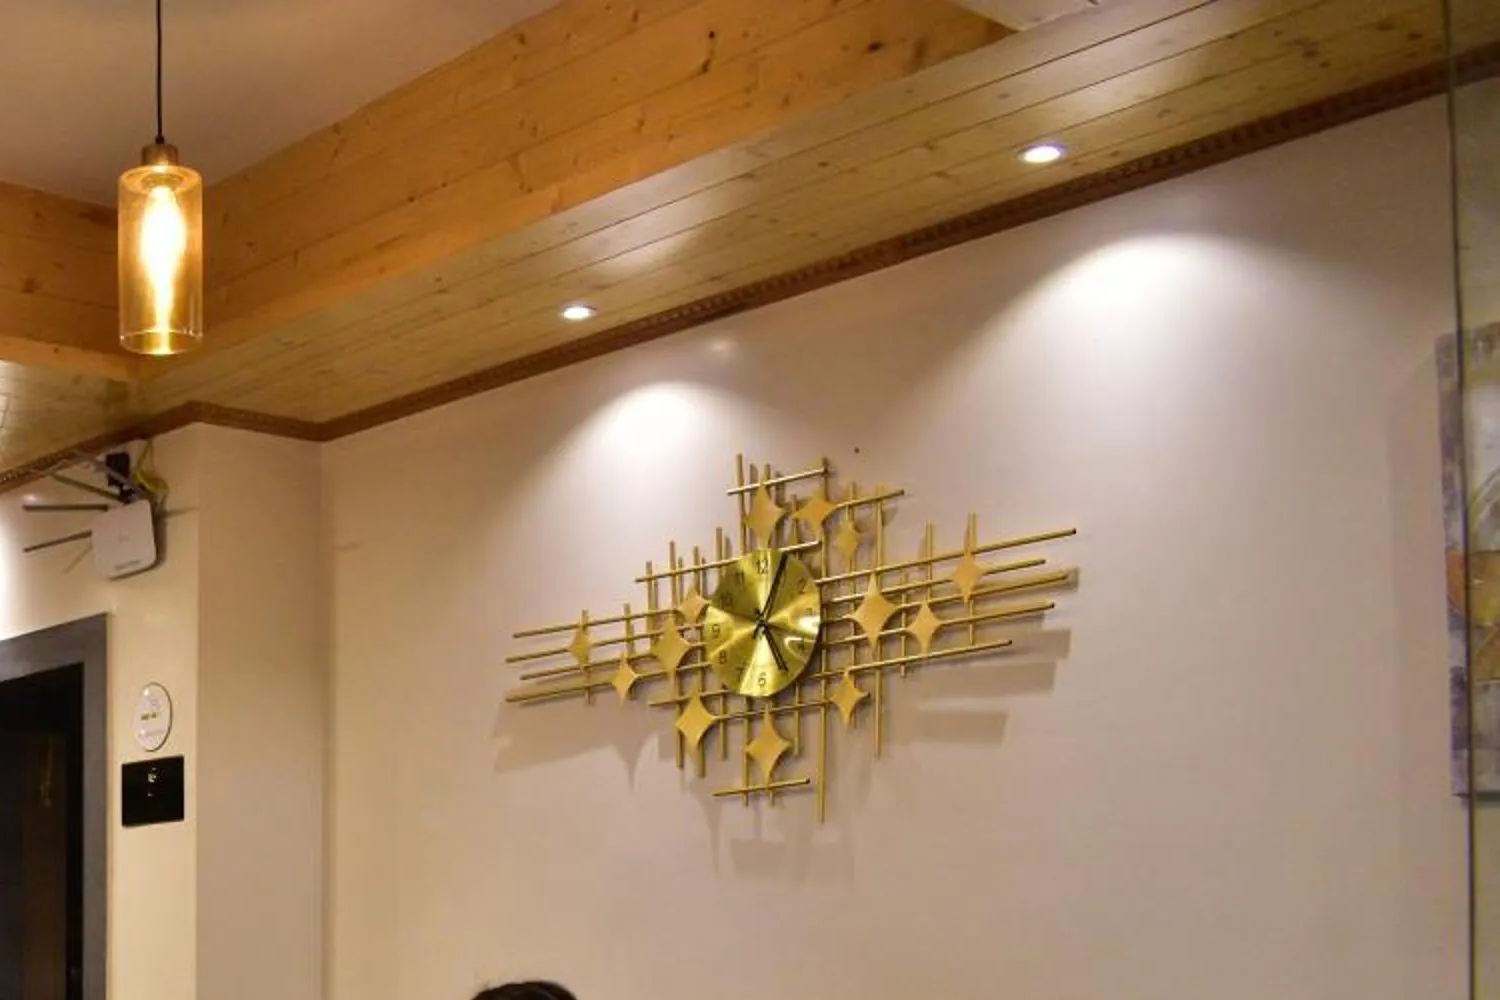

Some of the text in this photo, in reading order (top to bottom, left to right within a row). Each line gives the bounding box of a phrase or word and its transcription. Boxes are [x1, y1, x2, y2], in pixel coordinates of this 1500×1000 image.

[711, 623, 721, 639] 9
[718, 650, 727, 664] 8
[757, 671, 767, 686] 6
